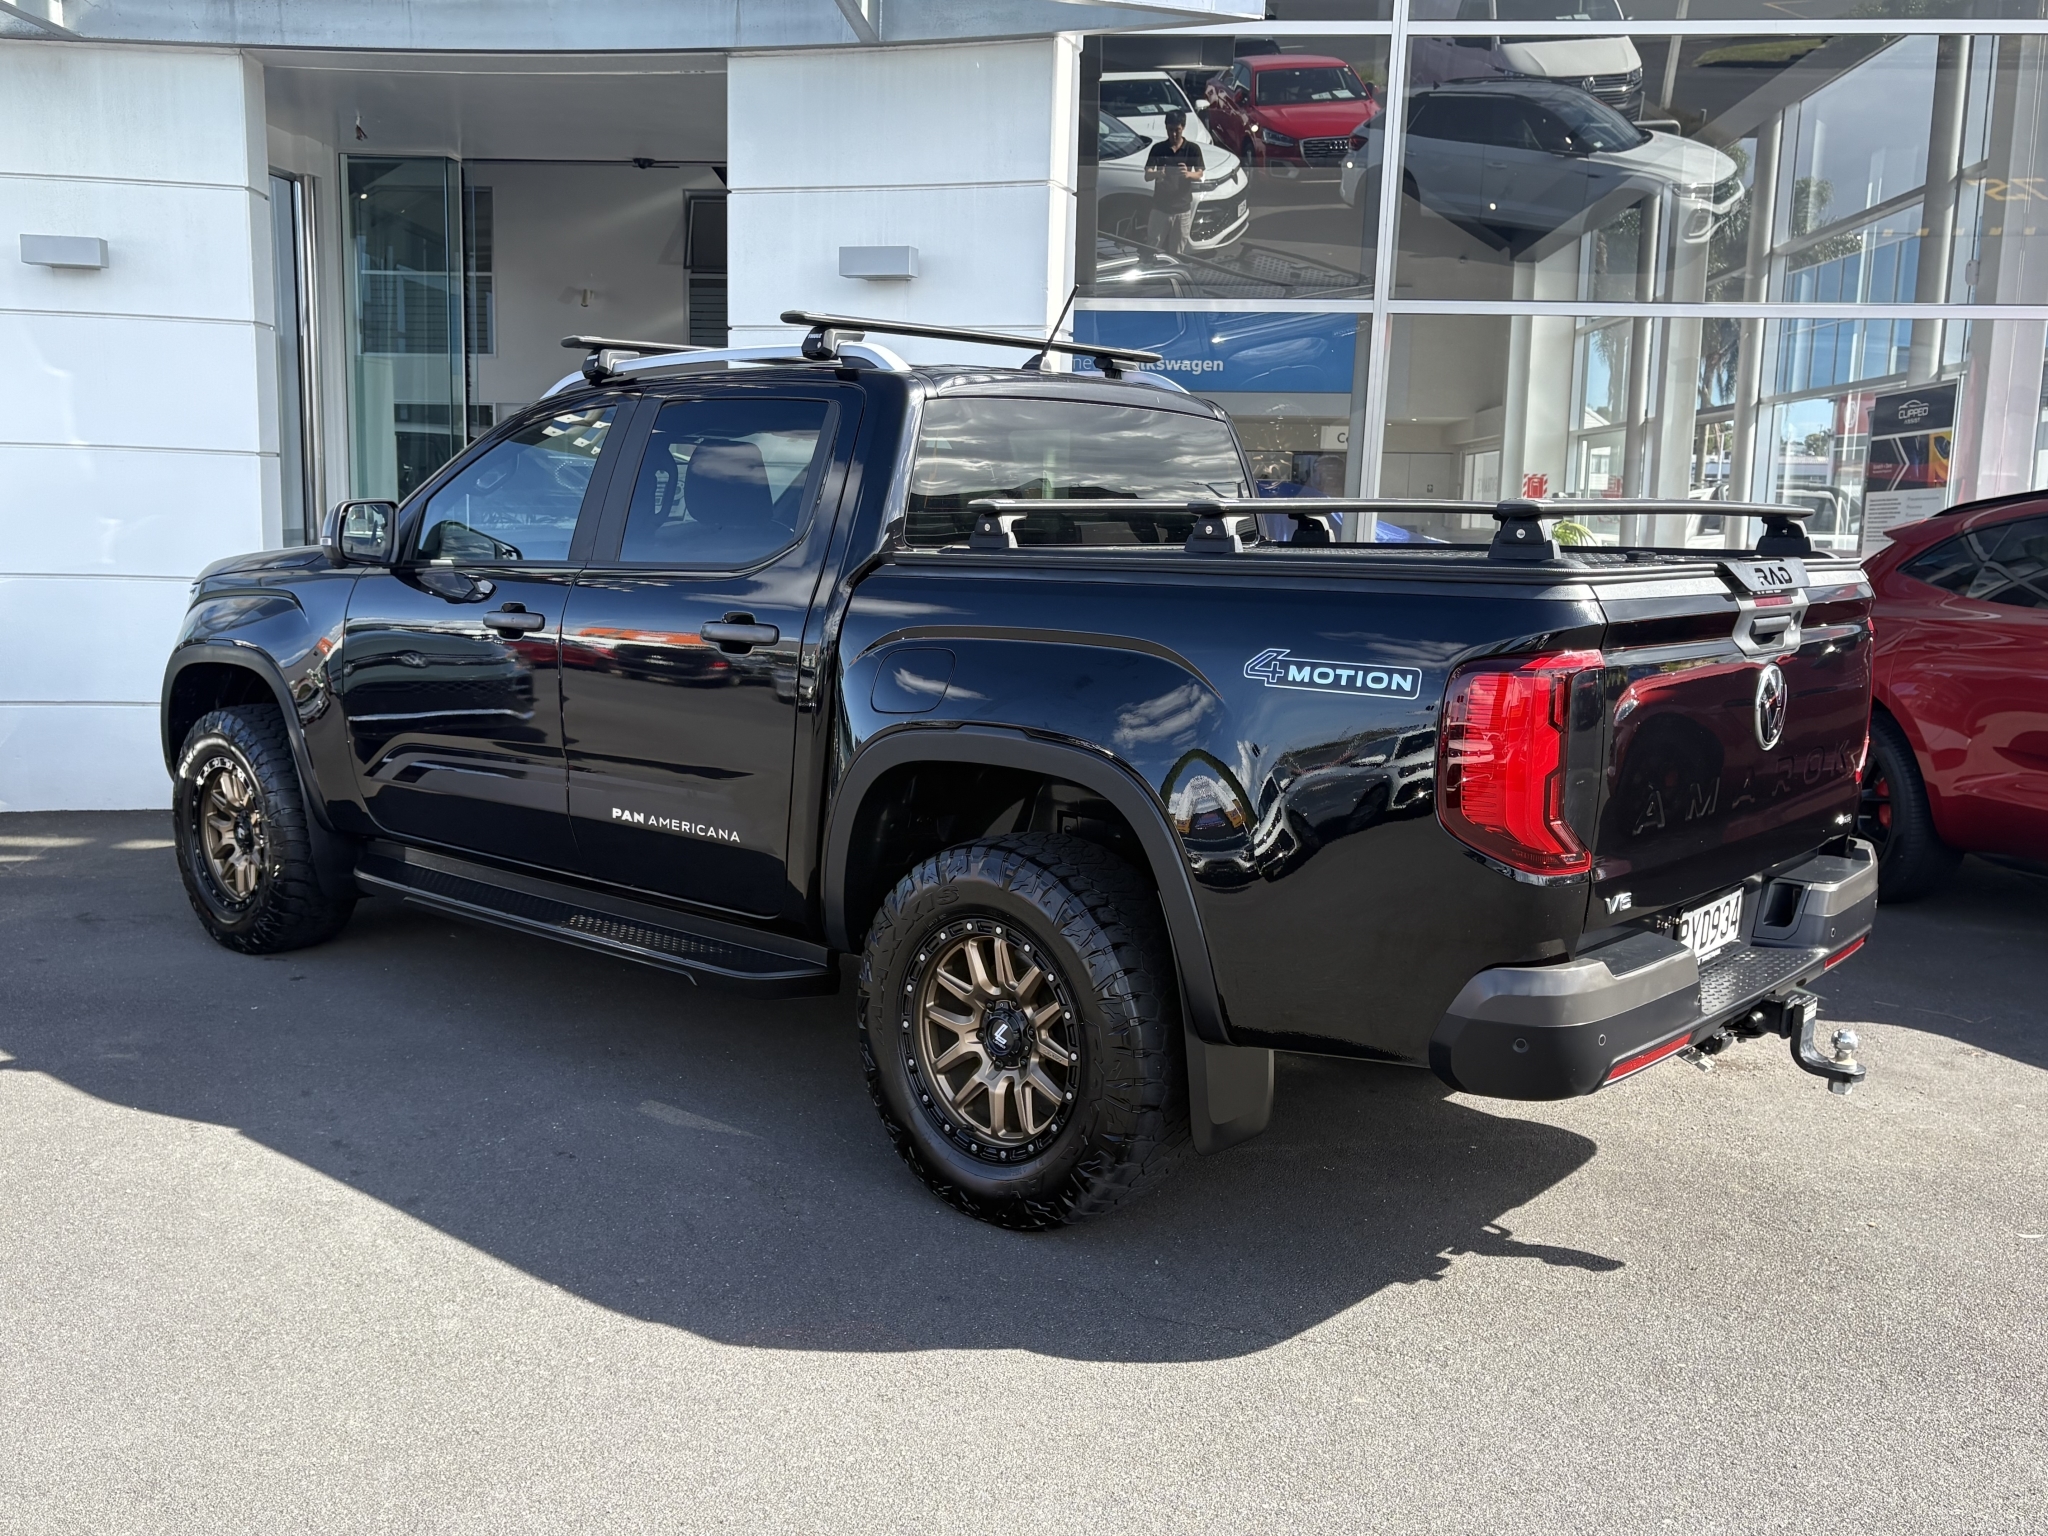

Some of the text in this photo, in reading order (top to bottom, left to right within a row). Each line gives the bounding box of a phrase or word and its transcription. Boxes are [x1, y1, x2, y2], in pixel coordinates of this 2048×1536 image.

[1073, 358, 1224, 375] ne lkswagen
[1337, 432, 1348, 444] C
[1754, 567, 1793, 586] RAD
[1244, 648, 1413, 692] 4MOTION
[1632, 738, 1850, 836] AMAROK
[612, 808, 741, 843] PAN AMERICANA
